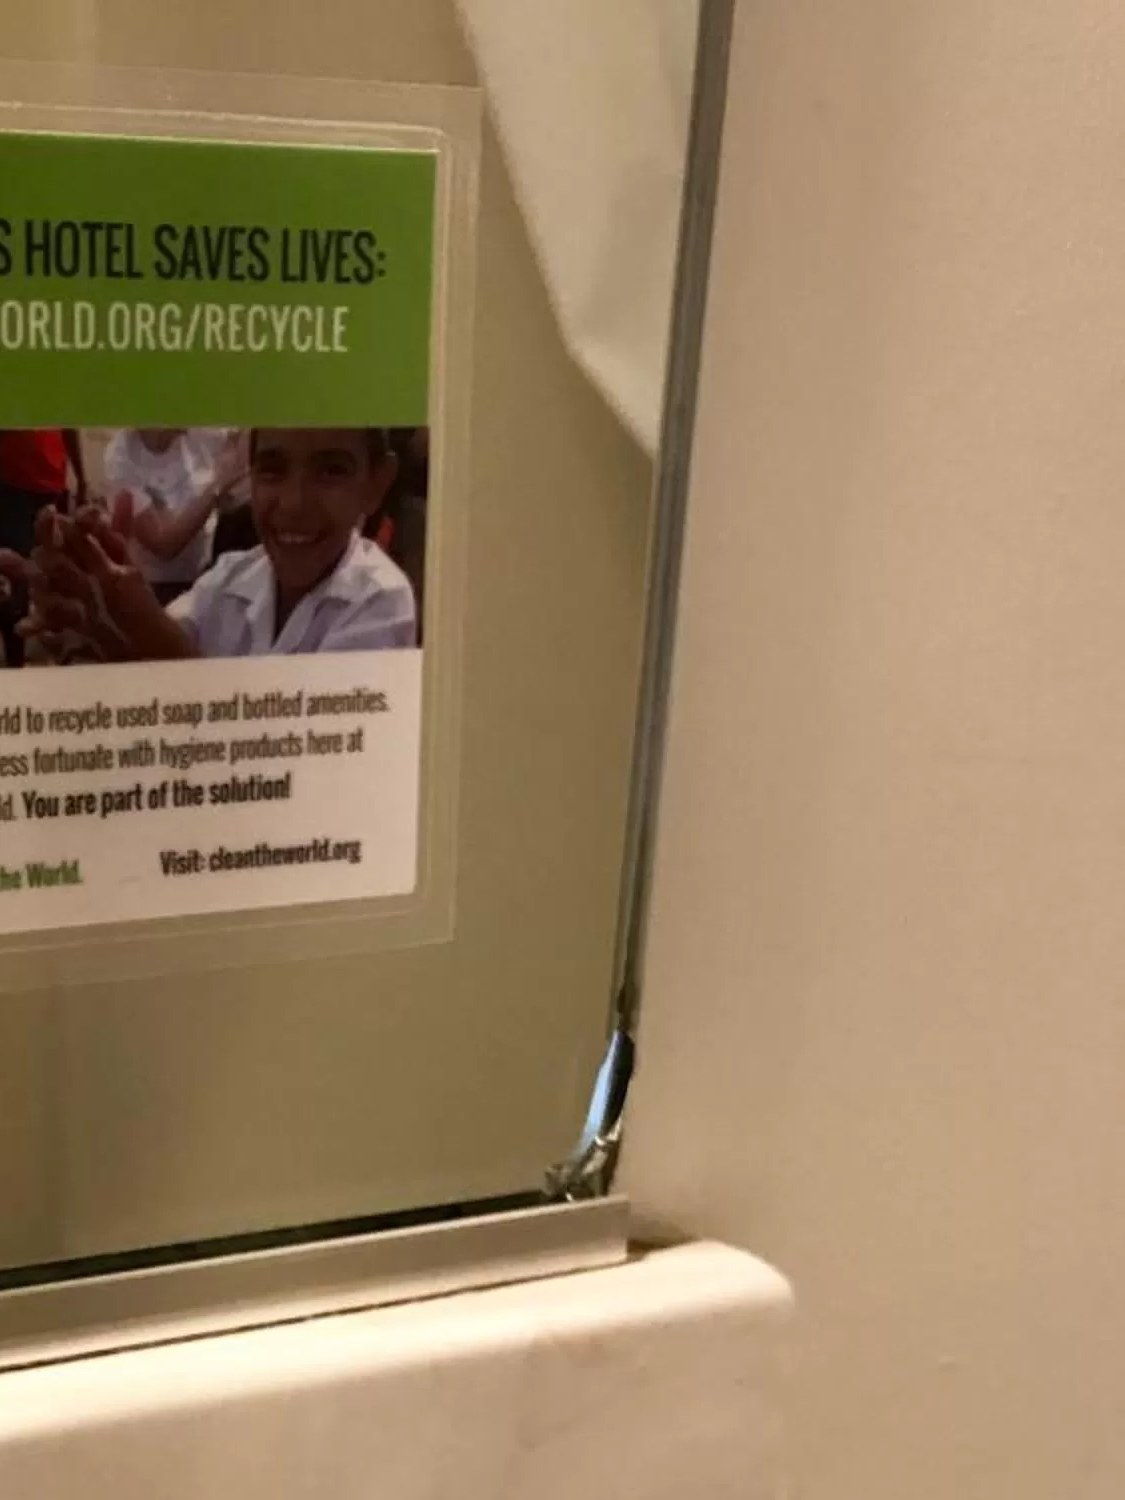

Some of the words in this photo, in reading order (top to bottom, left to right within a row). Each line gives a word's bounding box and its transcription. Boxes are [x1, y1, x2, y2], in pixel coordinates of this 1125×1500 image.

[24, 221, 143, 279] HOTEL
[154, 225, 270, 282] SAVES
[280, 230, 387, 284] LIVES:
[26, 707, 43, 732] to
[48, 702, 112, 734] recycle
[117, 698, 158, 728] used
[162, 702, 203, 728] soap
[207, 694, 240, 722] and
[242, 690, 303, 719] bottled
[34, 743, 113, 775] fortunate
[118, 741, 155, 768] with
[160, 737, 225, 769] hygiene
[230, 732, 302, 766] products
[307, 729, 343, 754] here
[347, 727, 363, 752] at
[22, 790, 59, 818] You
[65, 793, 96, 816] are
[101, 782, 143, 818] part
[148, 781, 169, 810] of
[173, 778, 204, 807] the
[209, 770, 291, 803] solution!
[26, 860, 82, 888] World.
[160, 849, 205, 876] Visit:
[209, 838, 362, 872] cleantheworld.org
